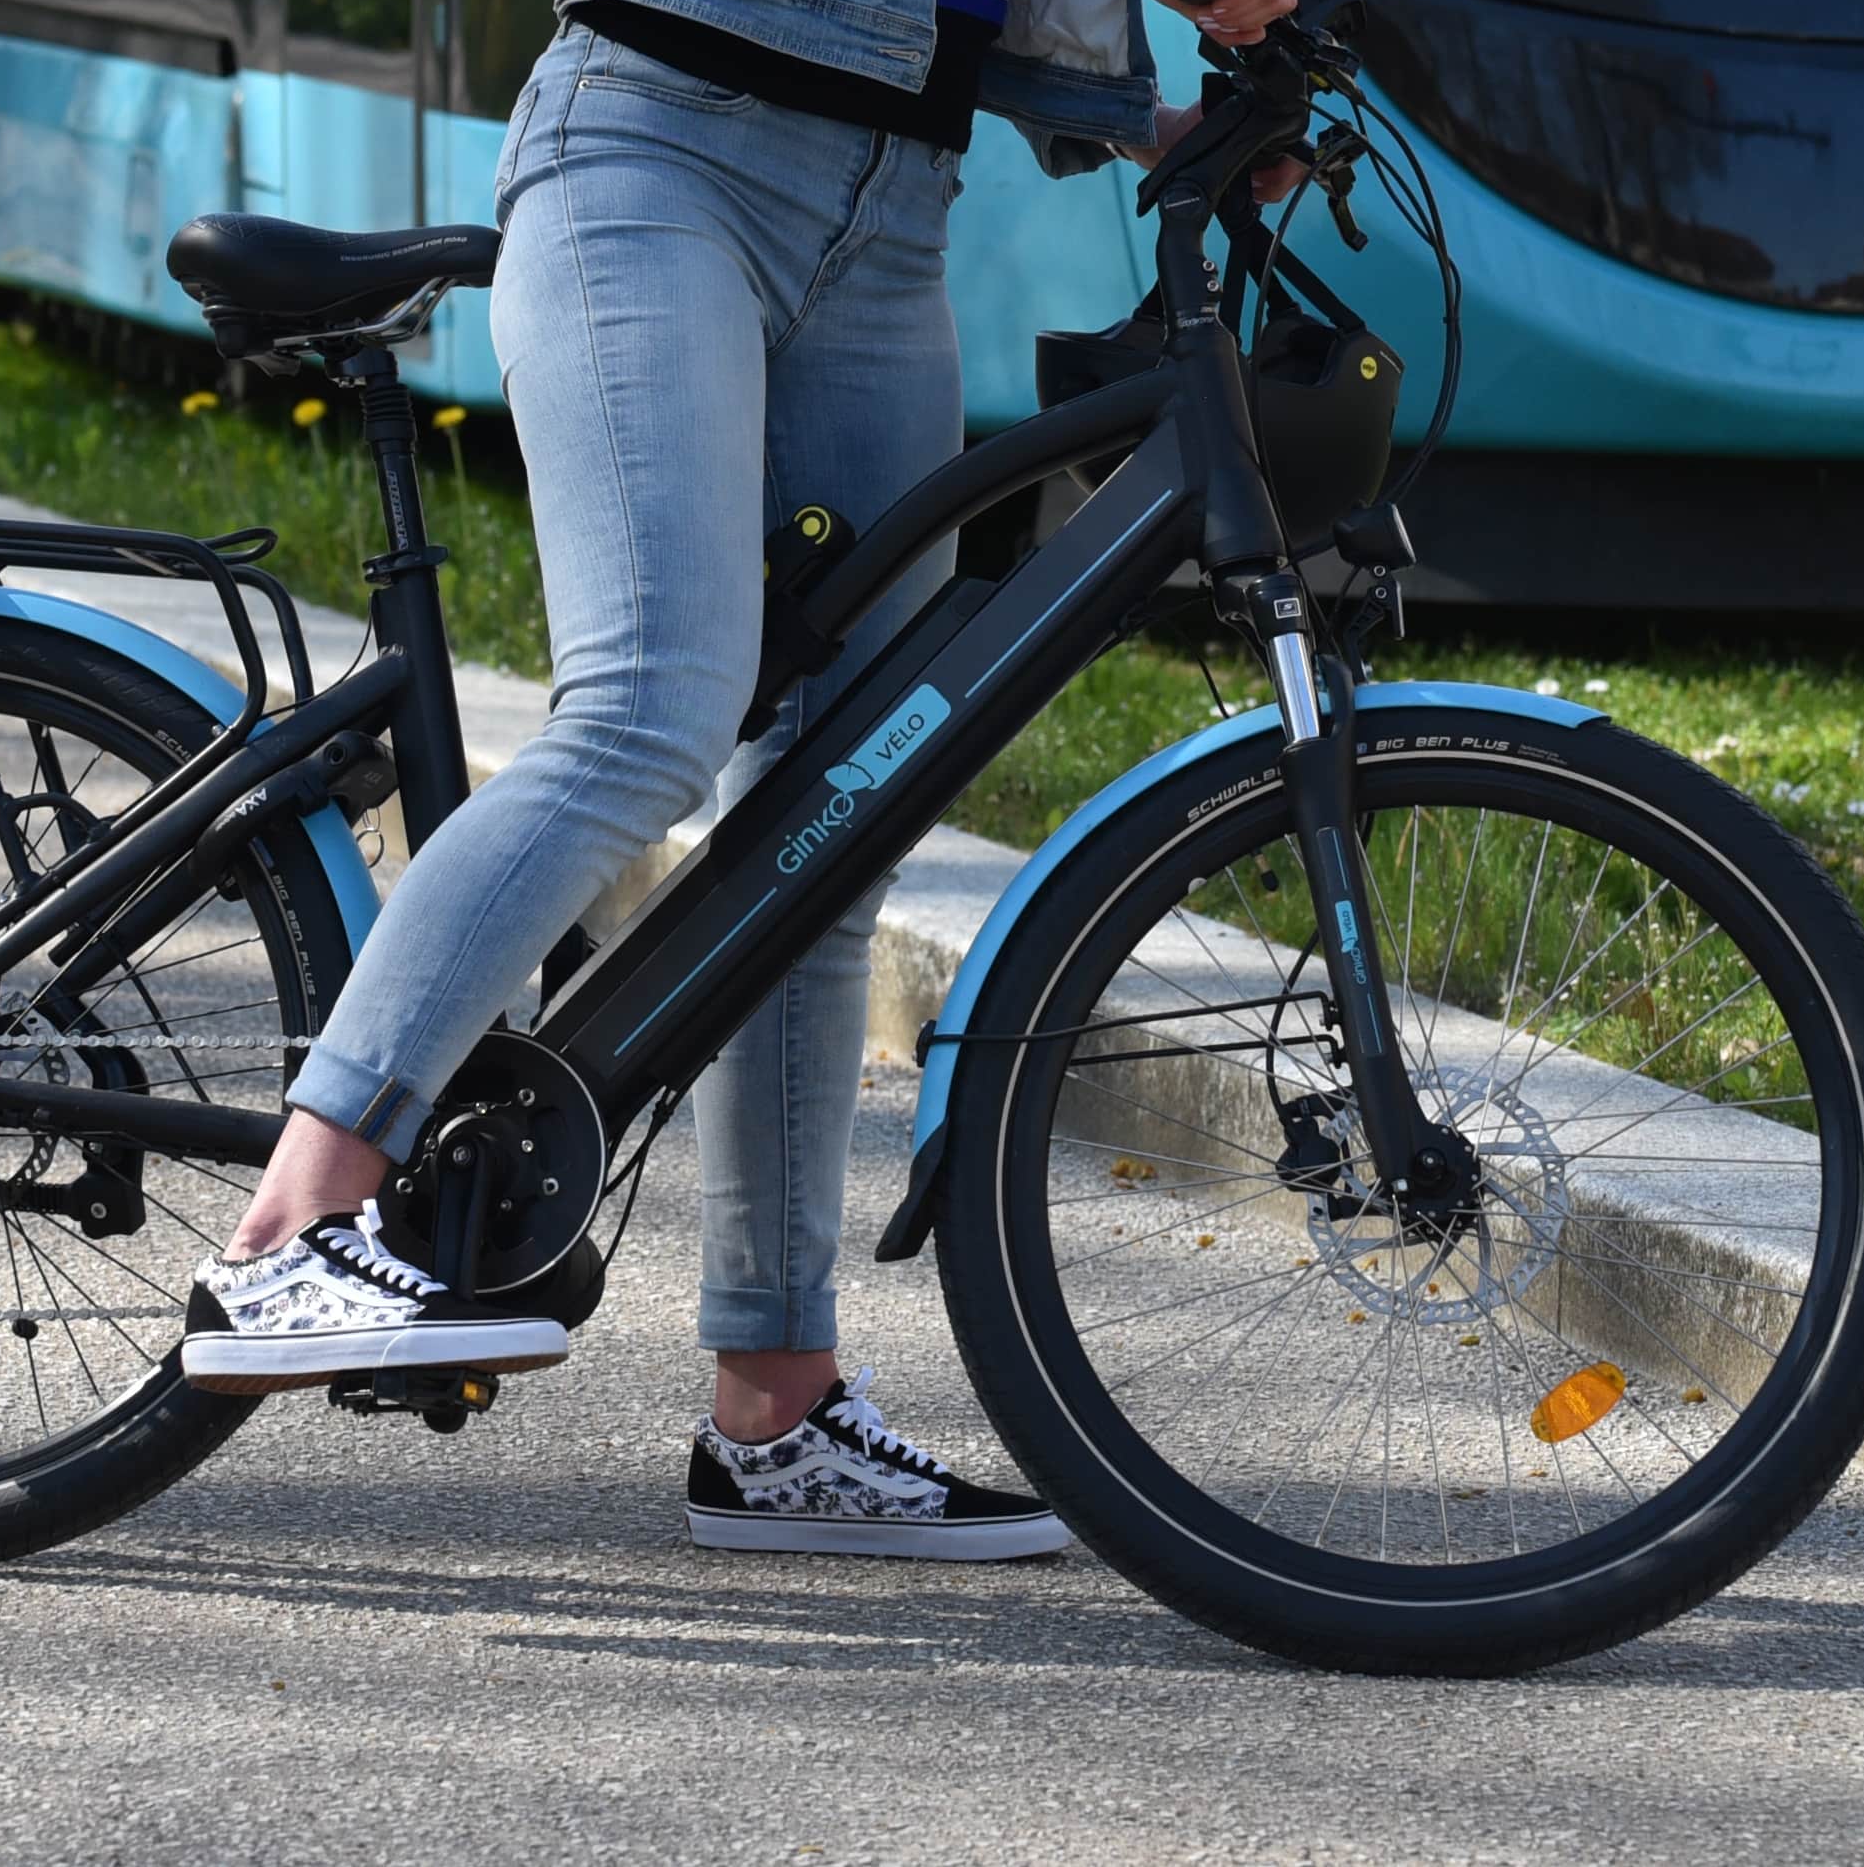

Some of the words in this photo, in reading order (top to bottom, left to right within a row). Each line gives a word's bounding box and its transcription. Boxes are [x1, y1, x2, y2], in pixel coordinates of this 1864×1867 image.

[874, 713, 926, 761] VÉLO
[1375, 738, 1406, 752] BIG
[1415, 736, 1451, 748] BEN
[1460, 736, 1511, 752] PLUS
[235, 787, 267, 816] AXA
